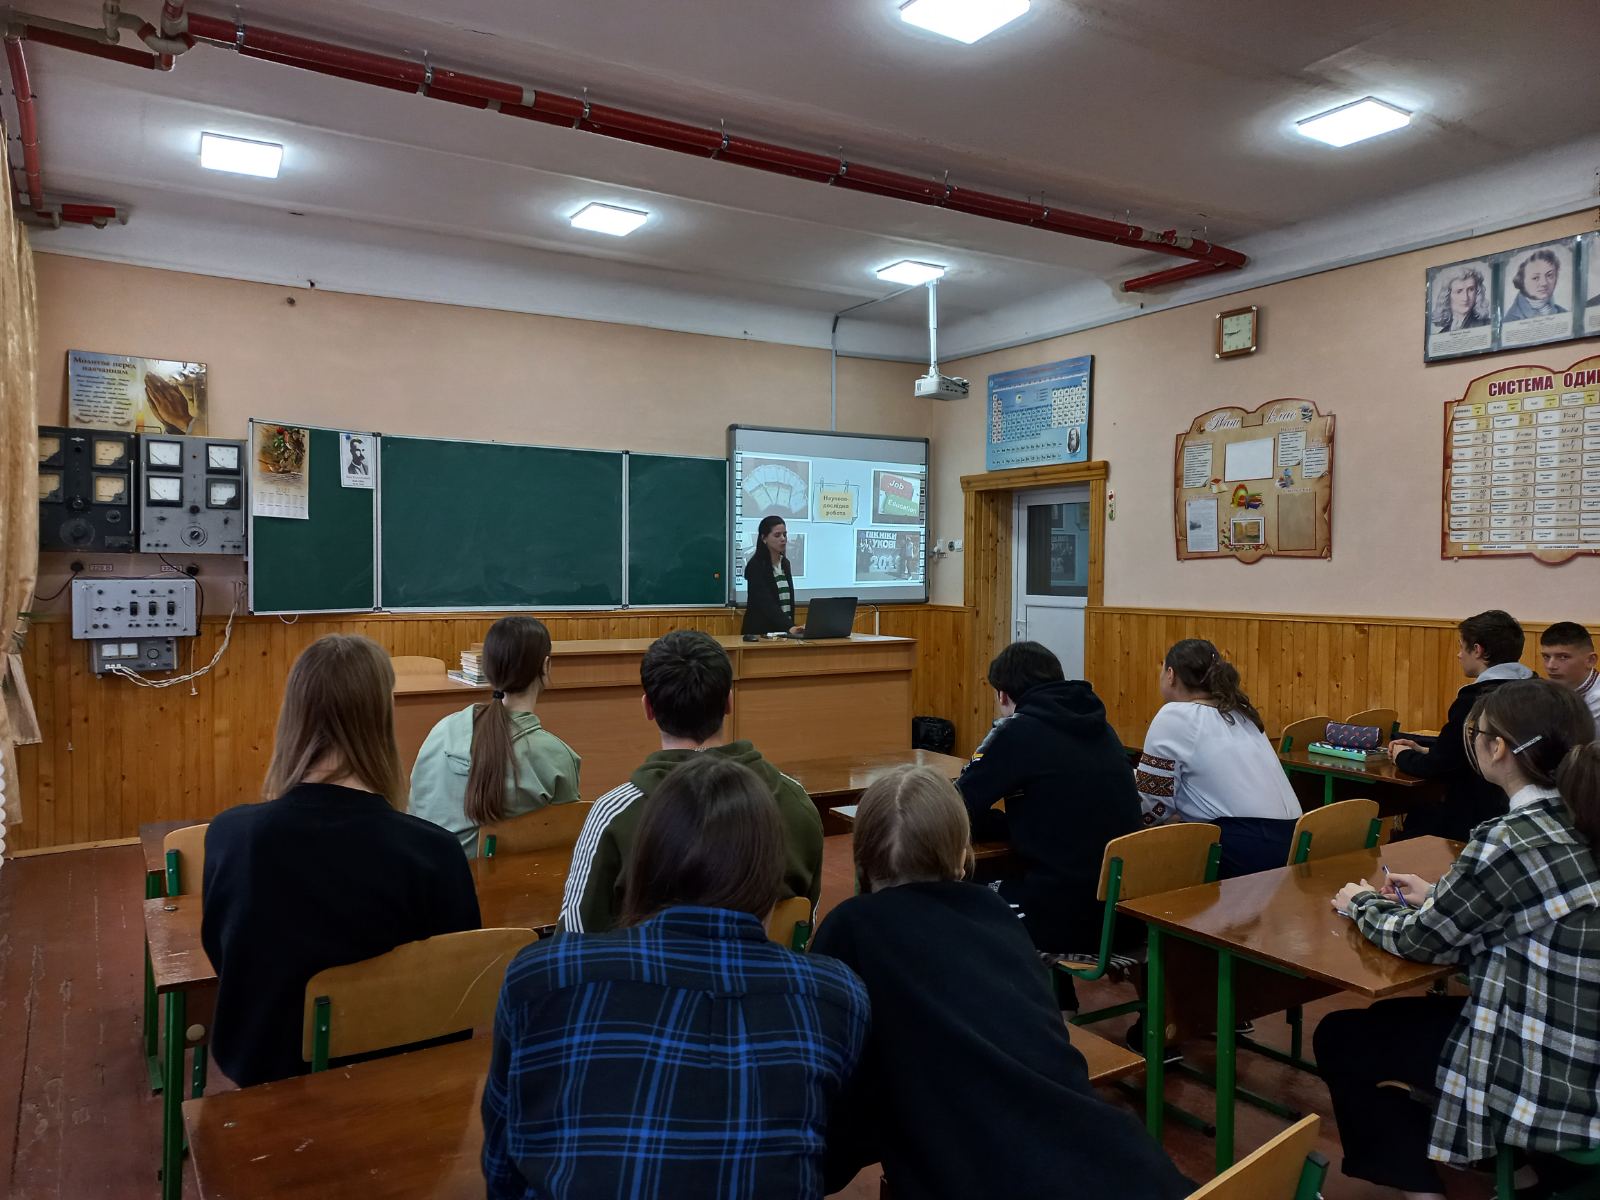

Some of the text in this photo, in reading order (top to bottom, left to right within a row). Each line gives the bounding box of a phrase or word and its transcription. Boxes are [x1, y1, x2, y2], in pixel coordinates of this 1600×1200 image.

[112, 361, 136, 370] перед
[1488, 375, 1554, 396] СИСТЕМА
[888, 480, 904, 490] Job
[888, 499, 917, 515] Education
